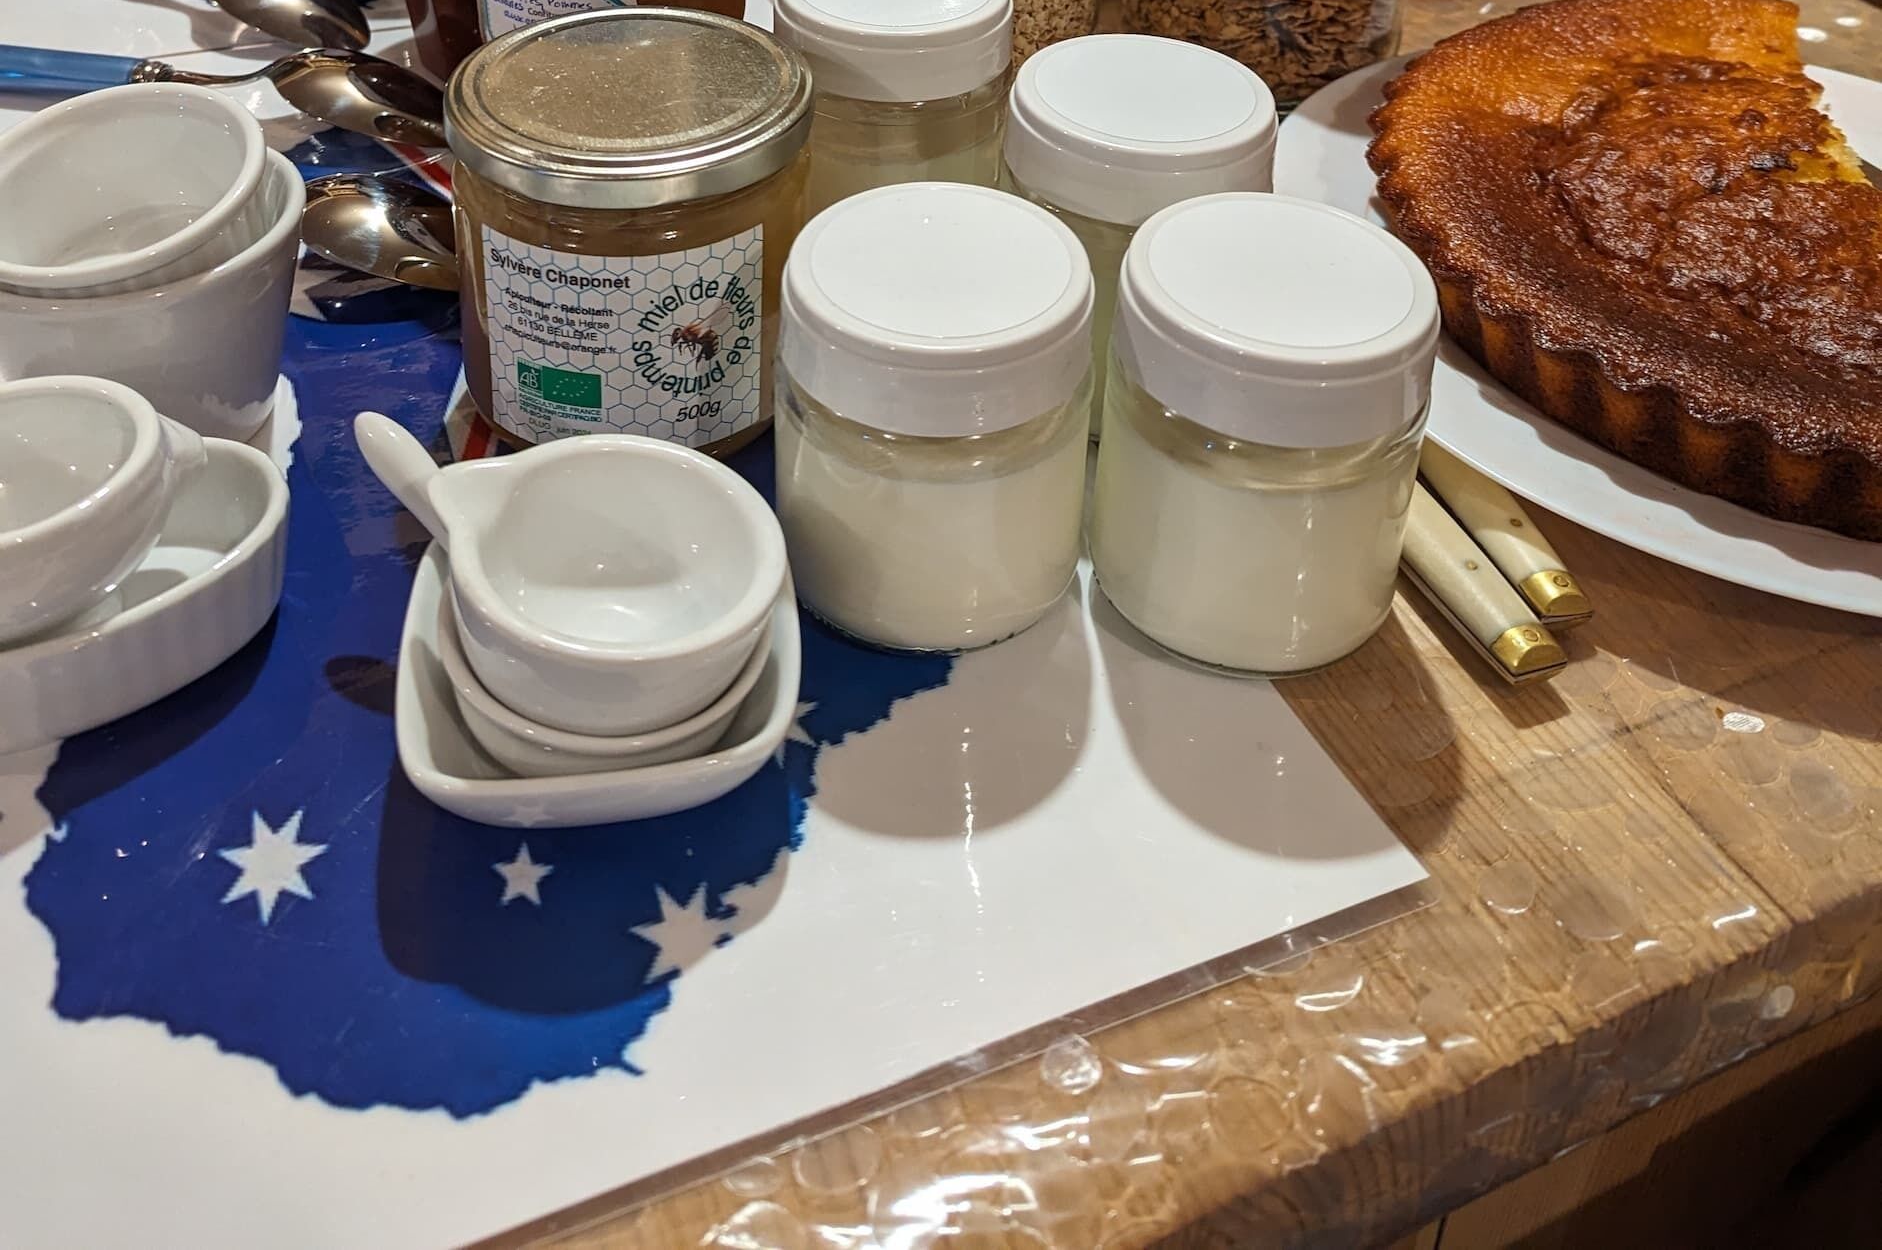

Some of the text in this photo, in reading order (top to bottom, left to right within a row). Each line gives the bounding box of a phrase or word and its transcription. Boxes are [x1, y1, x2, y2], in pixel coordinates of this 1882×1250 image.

[490, 247, 631, 290] Sylvère Chaponet
[517, 316, 545, 333] 61130
[534, 311, 550, 323] rue
[551, 315, 564, 325] de
[578, 319, 611, 330] Herse
[632, 275, 755, 398] miel de fleurs de printemps
[675, 400, 721, 423] 500g
